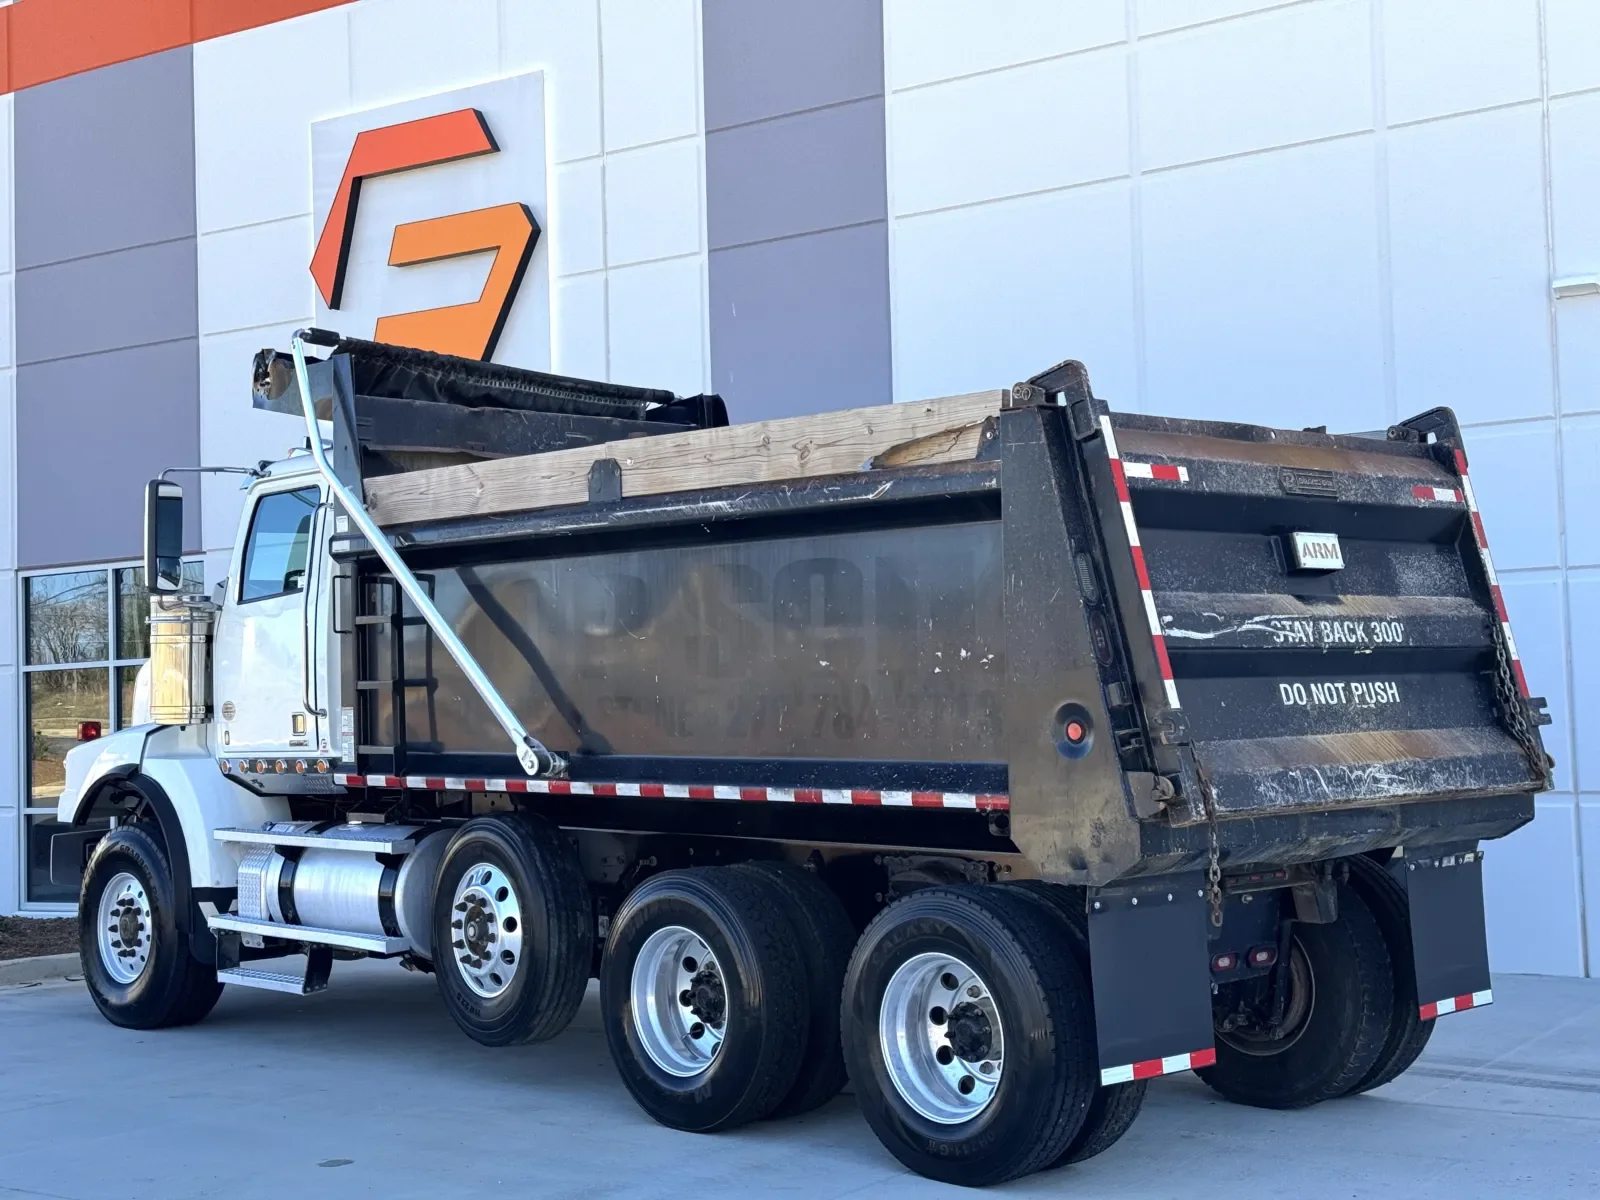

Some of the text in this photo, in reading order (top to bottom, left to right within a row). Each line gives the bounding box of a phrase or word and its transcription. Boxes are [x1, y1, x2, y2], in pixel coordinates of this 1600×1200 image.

[1302, 541, 1339, 559] ARM
[1271, 620, 1404, 642] STAY BACK 300'
[1279, 682, 1400, 705] DO NOT PUSH
